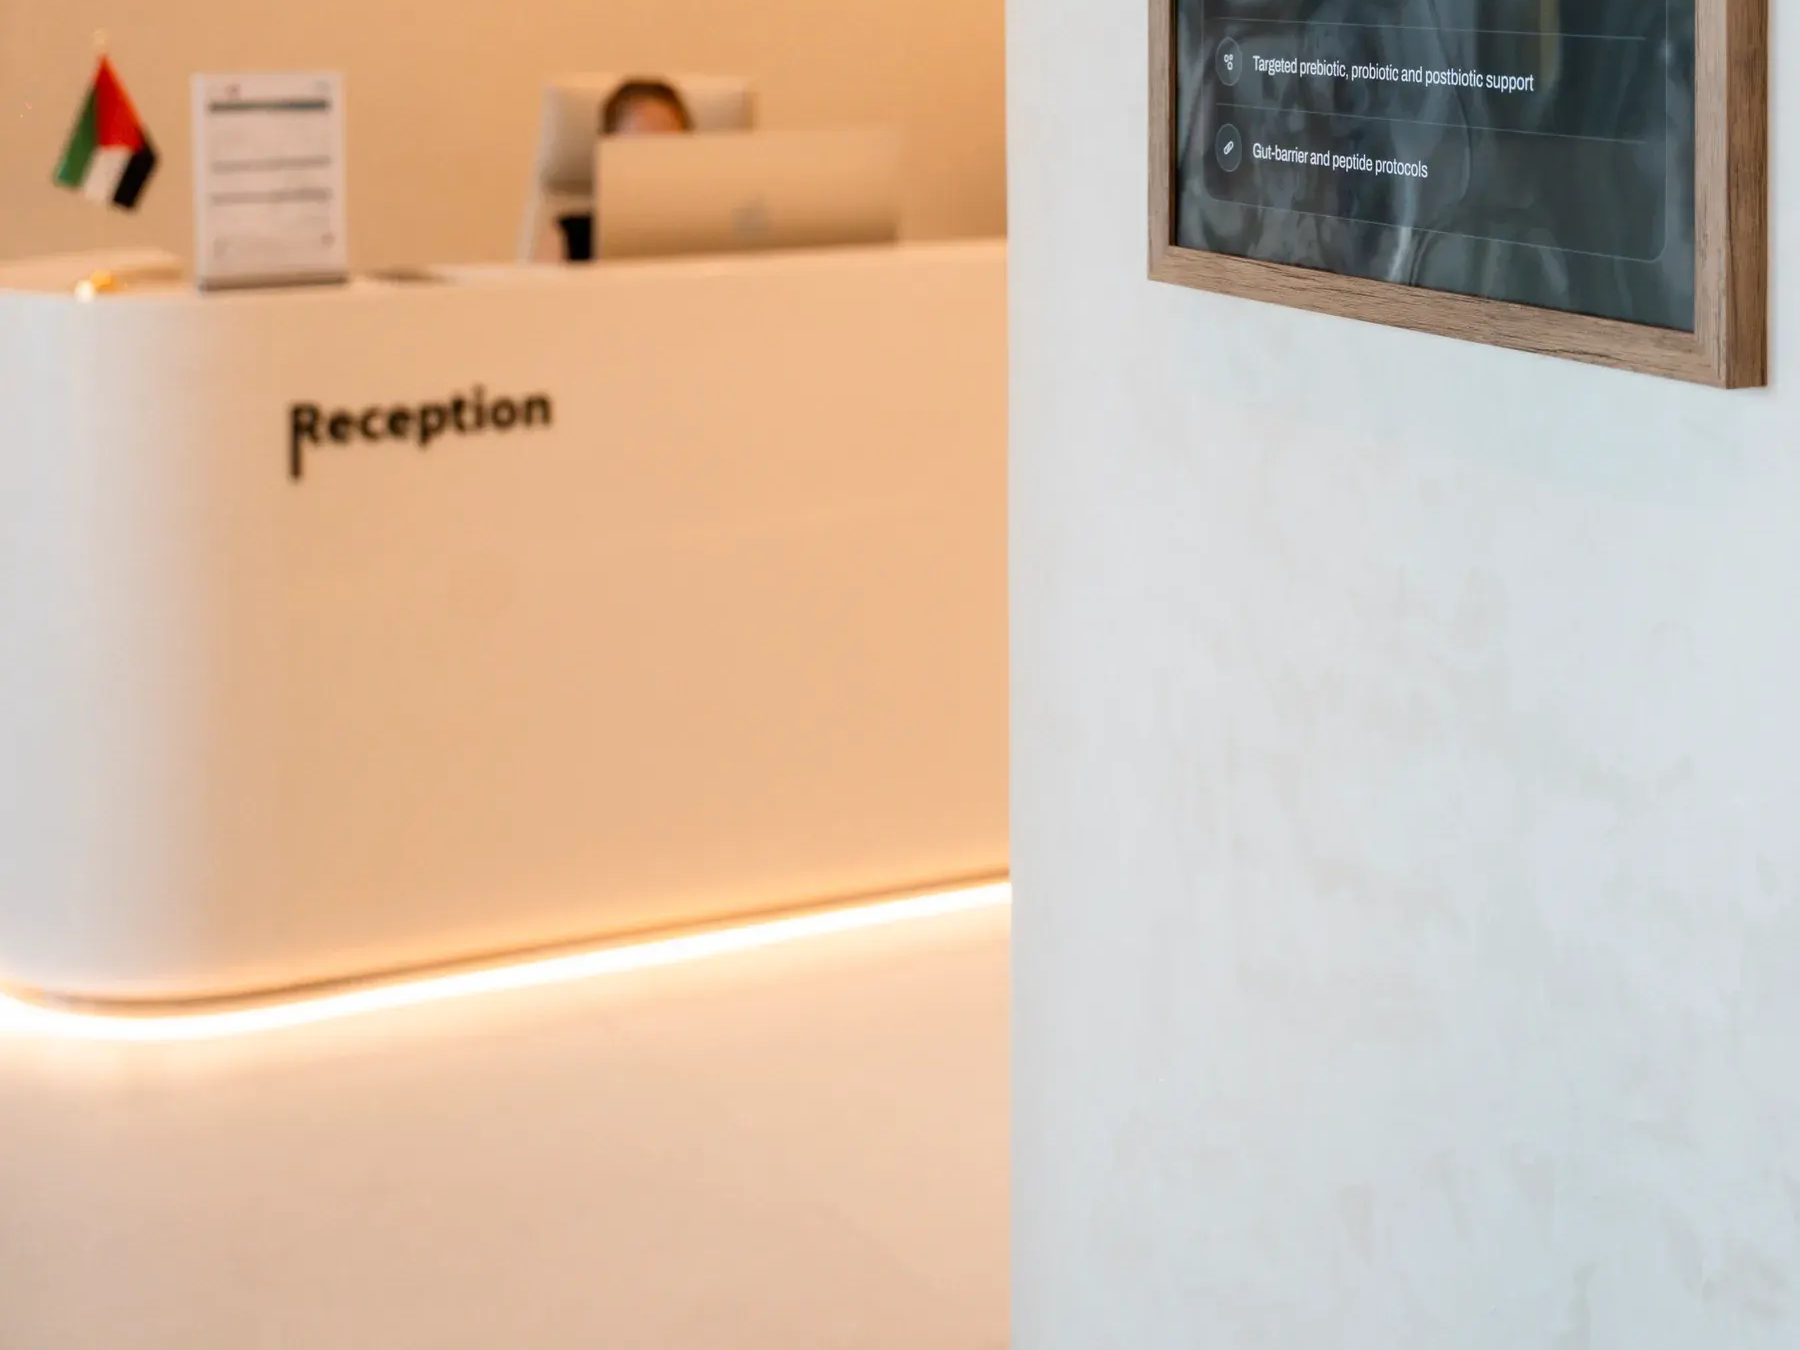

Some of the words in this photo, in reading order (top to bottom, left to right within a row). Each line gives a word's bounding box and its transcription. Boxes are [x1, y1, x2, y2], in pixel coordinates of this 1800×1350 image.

[1252, 55, 1298, 77] Targeted
[1299, 58, 1349, 80] prebiotic,
[1351, 62, 1399, 83] probiotic
[1401, 64, 1422, 83] and
[1425, 66, 1483, 88] postbiotic
[1485, 74, 1534, 93] support
[1252, 142, 1308, 164] Gut-barrier
[1310, 148, 1330, 167] and
[1332, 151, 1373, 172] peptide
[1375, 154, 1428, 178] protocols
[289, 383, 553, 483] Reception
